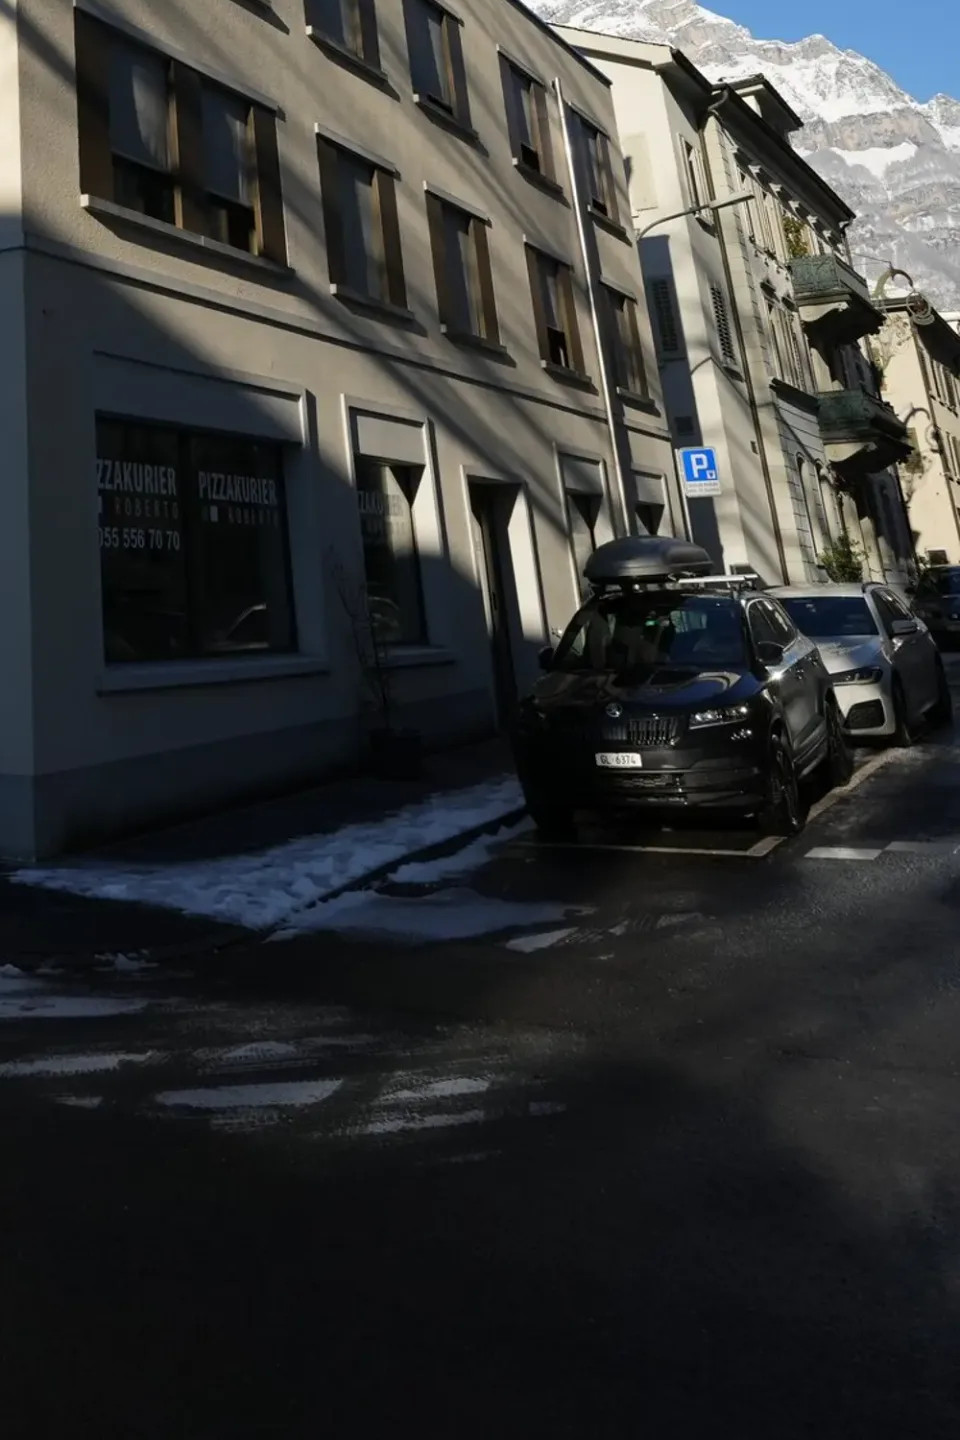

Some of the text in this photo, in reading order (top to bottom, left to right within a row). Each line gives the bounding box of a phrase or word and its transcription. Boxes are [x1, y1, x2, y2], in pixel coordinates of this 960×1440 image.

[690, 453, 709, 479] P
[198, 469, 278, 507] PIZZAKURIER
[123, 527, 145, 549] 556
[147, 528, 163, 551] 70
[166, 530, 180, 551] 70
